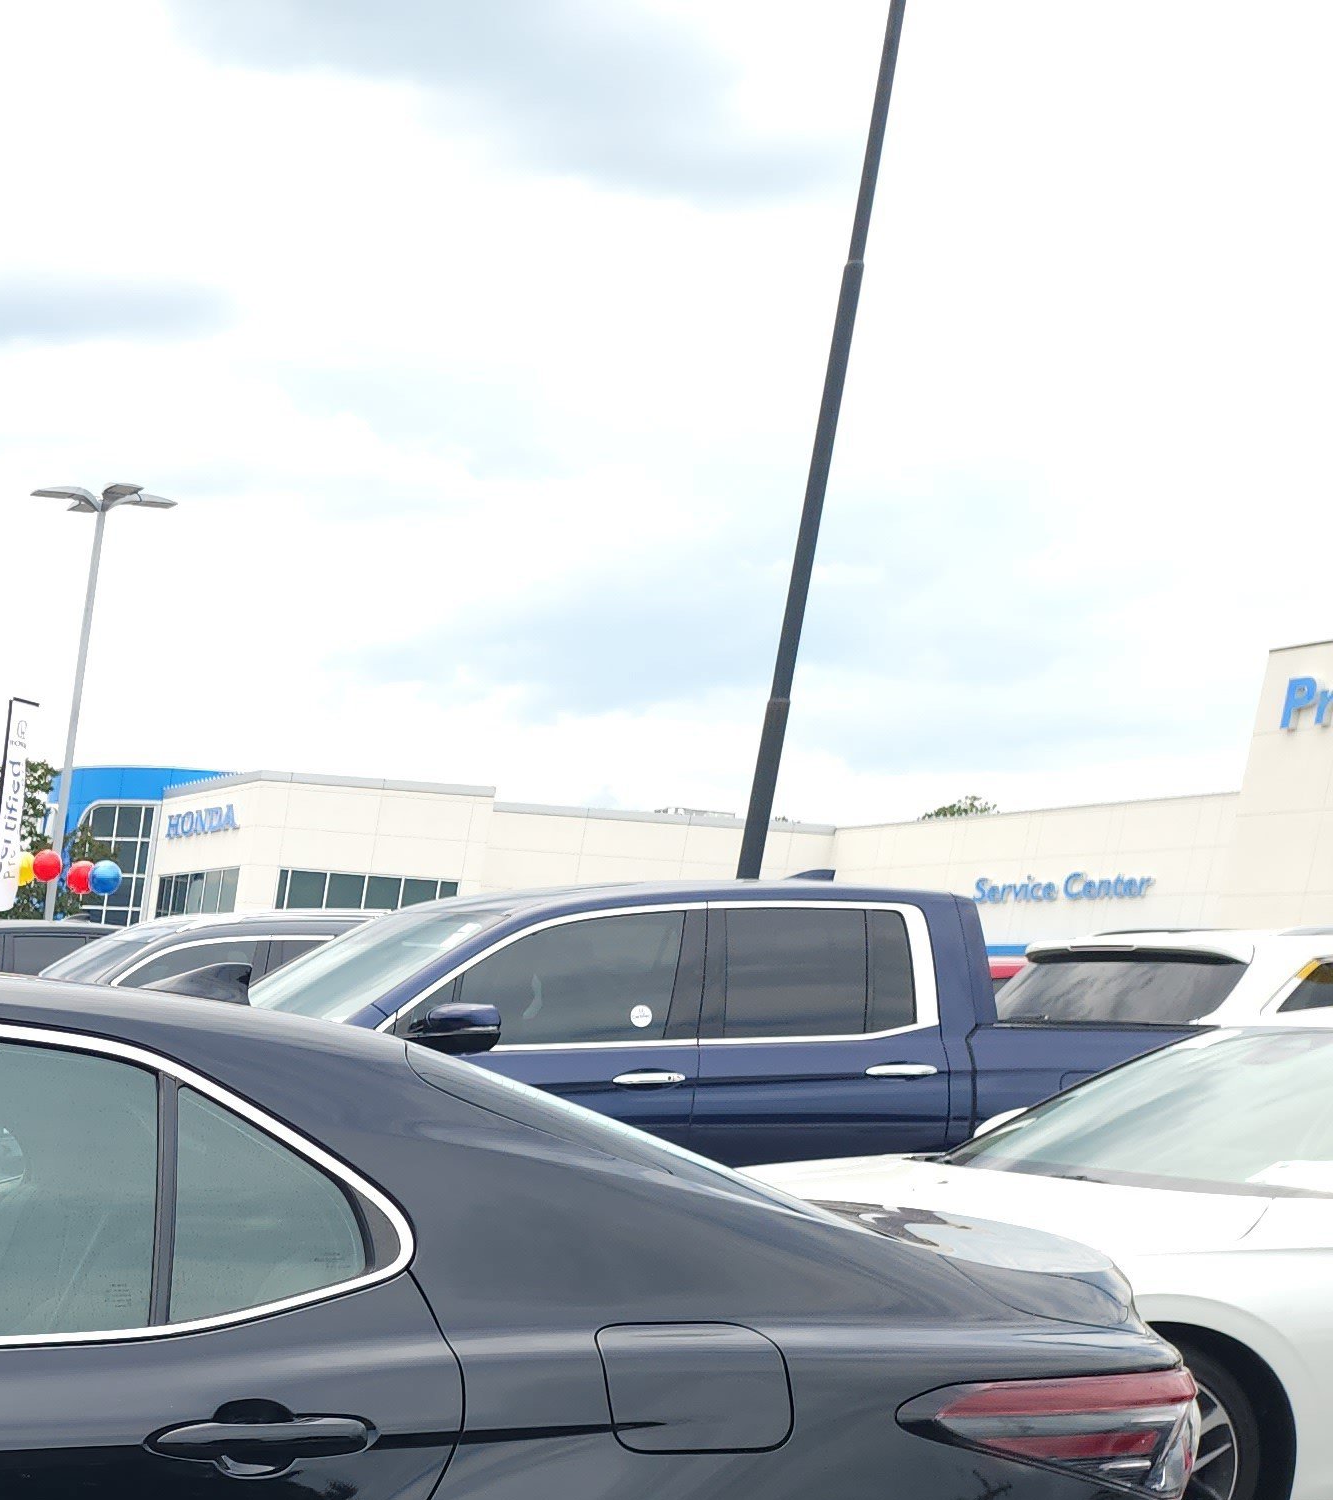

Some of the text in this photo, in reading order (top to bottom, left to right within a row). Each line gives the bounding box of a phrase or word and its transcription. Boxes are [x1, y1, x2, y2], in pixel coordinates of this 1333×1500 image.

[165, 804, 241, 840] HONDA
[973, 872, 1155, 904] Service Center
